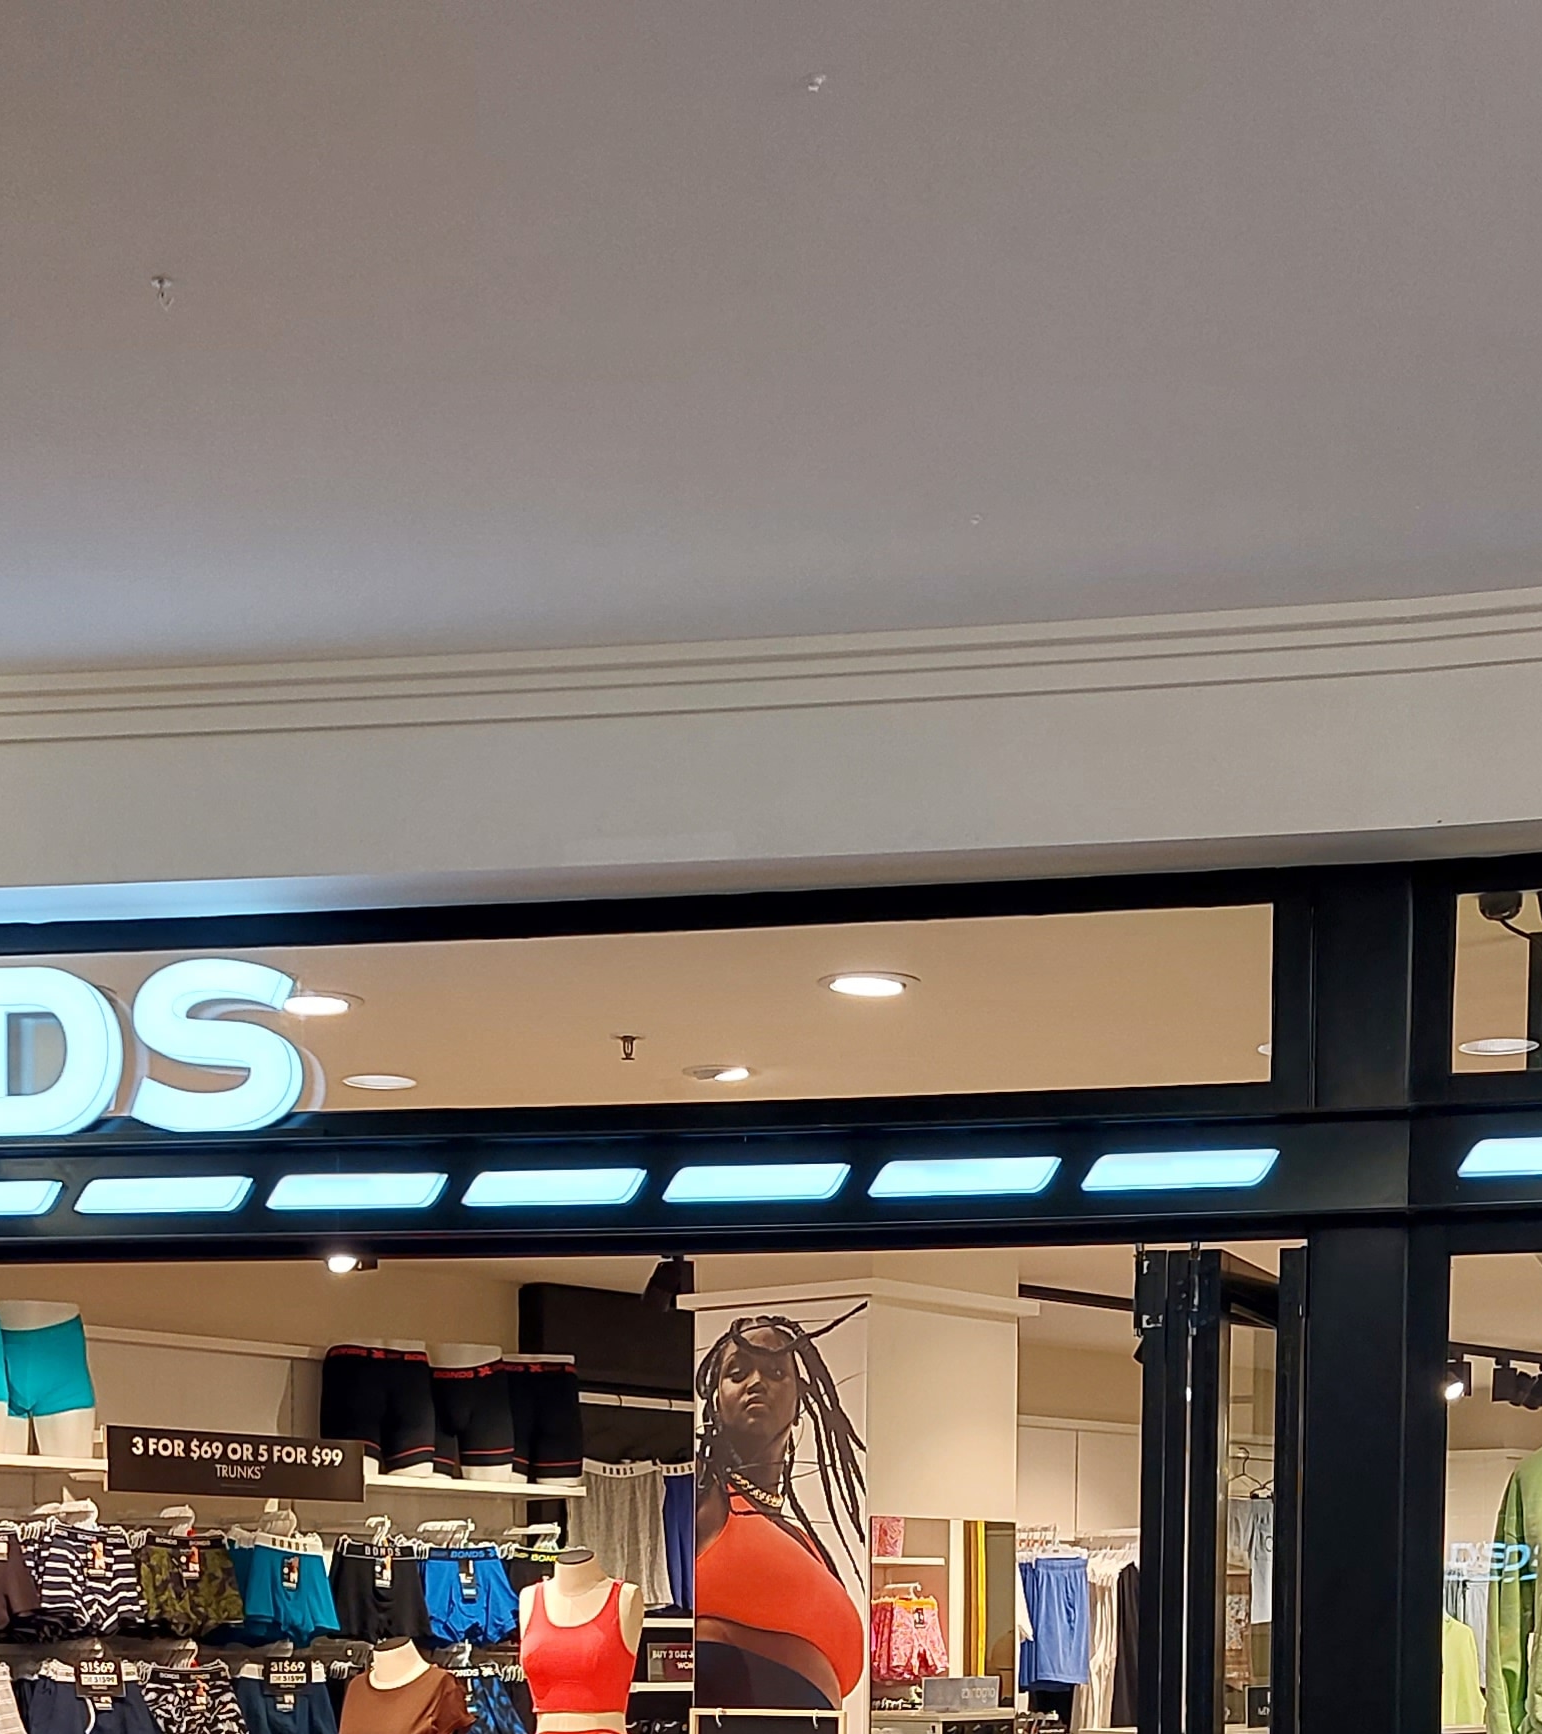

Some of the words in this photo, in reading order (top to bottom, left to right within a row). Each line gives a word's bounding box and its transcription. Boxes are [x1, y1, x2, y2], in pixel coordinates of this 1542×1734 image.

[132, 1436, 144, 1456] 3
[148, 1437, 185, 1458] FOR
[190, 1439, 223, 1461] $69
[227, 1442, 254, 1462] OR
[258, 1444, 268, 1462] 5
[273, 1445, 308, 1465] FOR
[311, 1446, 343, 1467] $99
[271, 1537, 308, 1552] BONDS
[365, 1545, 401, 1558] BONDS
[284, 1660, 305, 1672] $69
